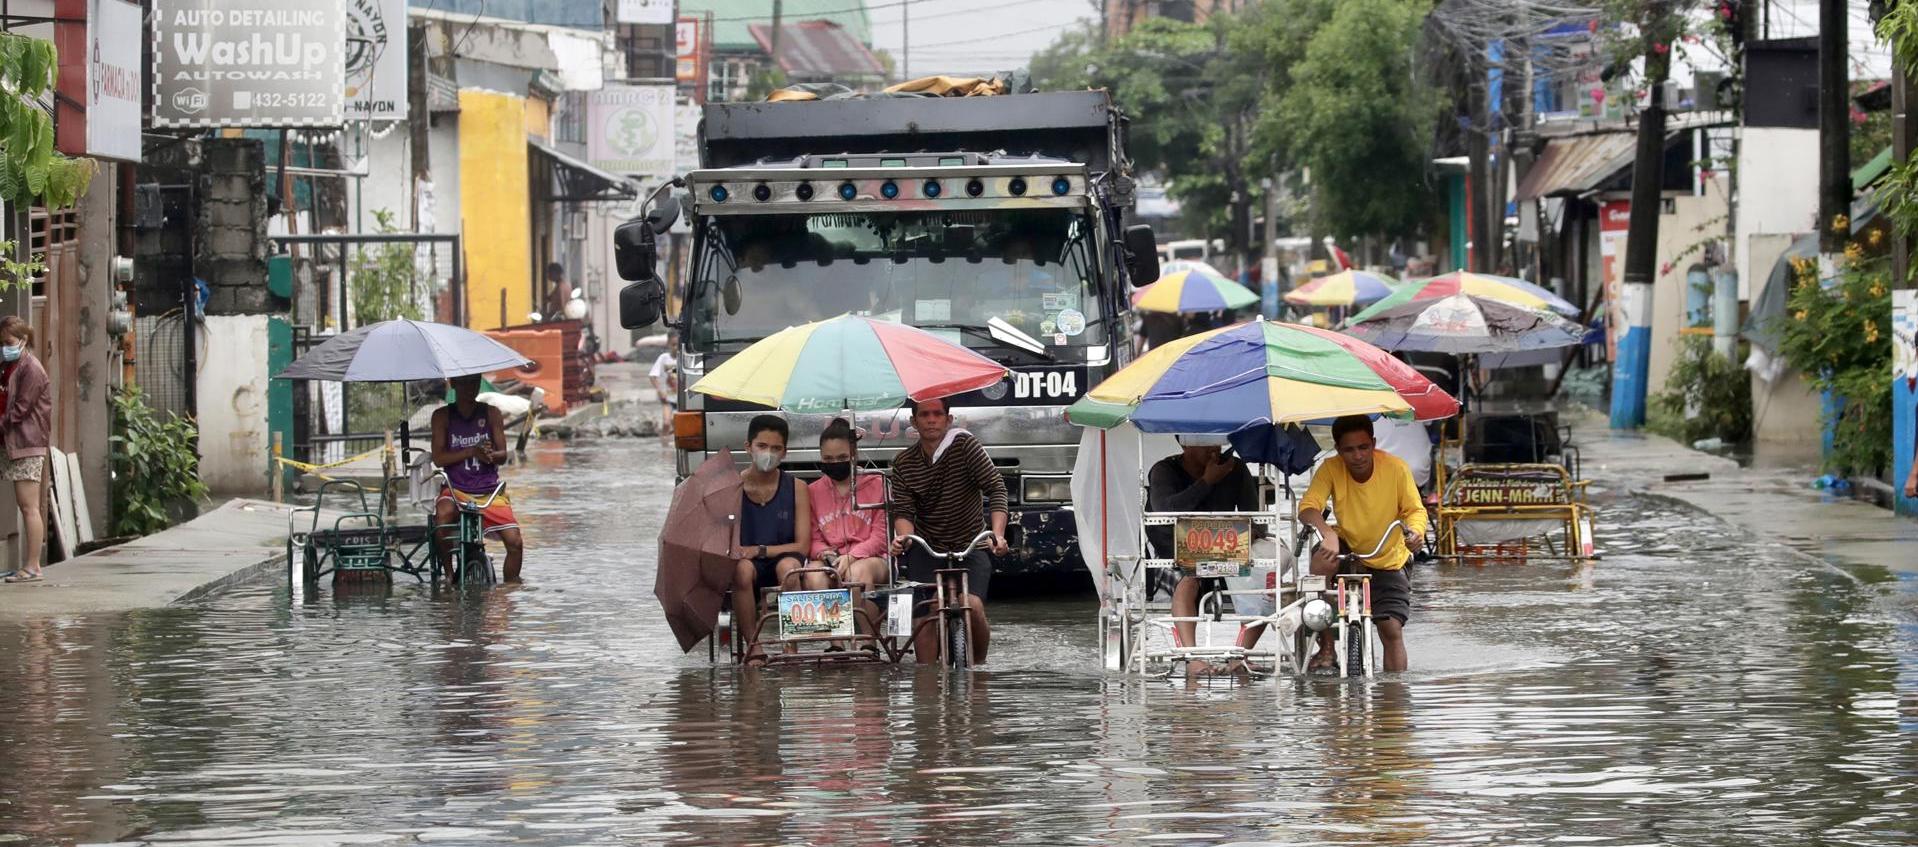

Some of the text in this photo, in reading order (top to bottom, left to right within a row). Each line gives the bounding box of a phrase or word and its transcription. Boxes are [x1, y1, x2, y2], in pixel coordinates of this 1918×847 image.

[174, 10, 325, 26] AUTO DETAILING
[173, 32, 328, 71] WashUp
[174, 70, 323, 81] AUTOWASH
[254, 92, 327, 108] 432-5122
[354, 101, 395, 112] NAYON
[1014, 371, 1077, 398] DT-04
[1186, 528, 1239, 553] 0049
[791, 601, 841, 625] 0014
